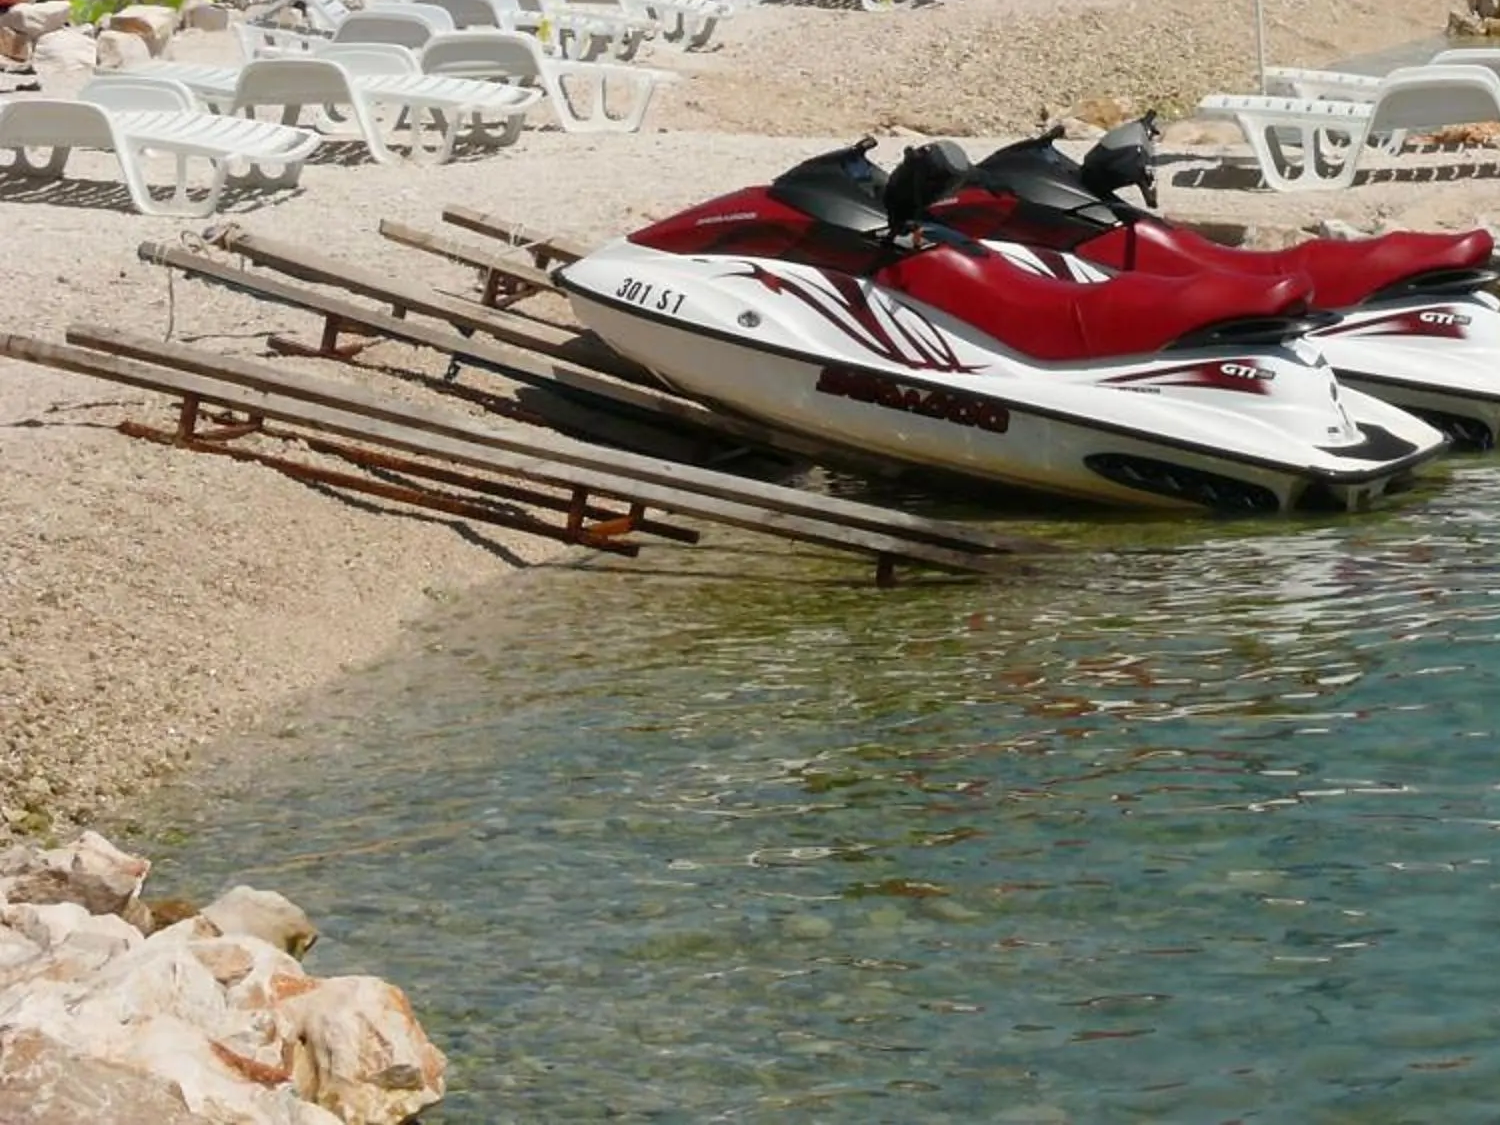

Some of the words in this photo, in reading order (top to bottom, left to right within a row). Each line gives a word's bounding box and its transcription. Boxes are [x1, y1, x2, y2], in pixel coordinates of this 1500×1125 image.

[616, 277, 652, 305] 301
[1420, 311, 1455, 325] GTI
[1220, 363, 1257, 379] GTI
